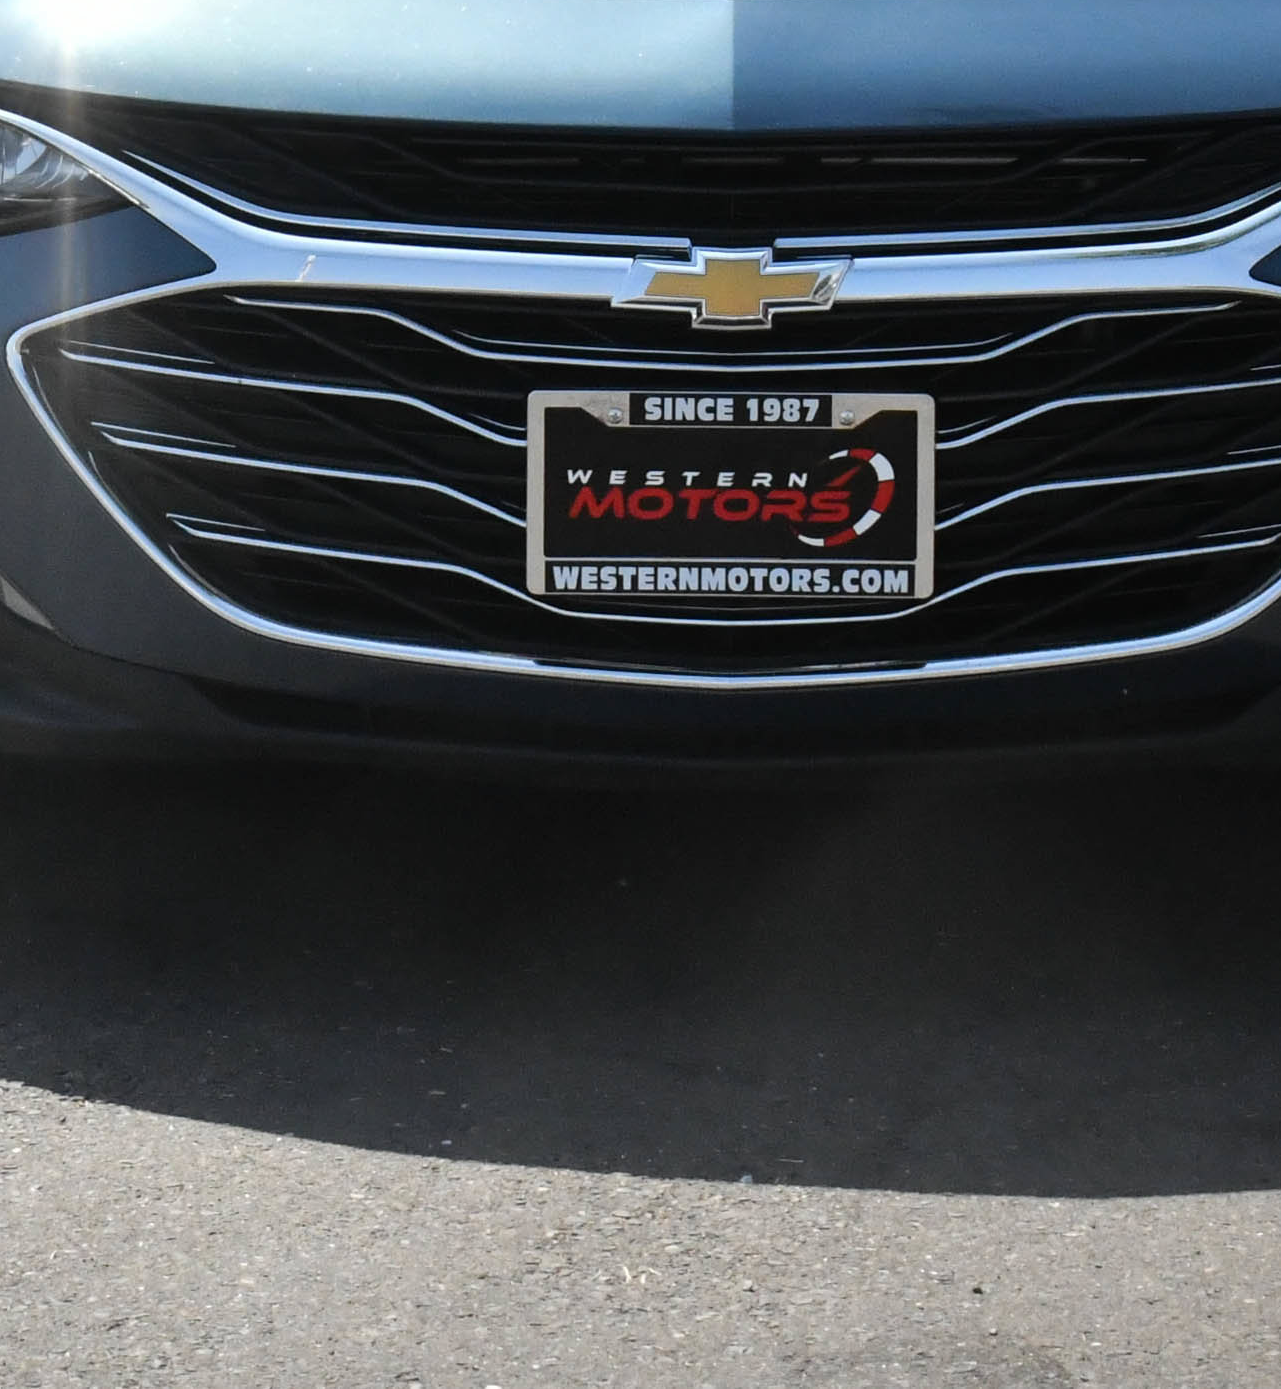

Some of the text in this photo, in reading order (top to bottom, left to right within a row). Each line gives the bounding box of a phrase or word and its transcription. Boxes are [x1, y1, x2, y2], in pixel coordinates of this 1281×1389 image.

[643, 396, 821, 423] SINCE 1987
[566, 468, 809, 489] WESTERN
[568, 485, 852, 523] MOTORS
[552, 564, 910, 594] WESTERNMOTORS.COM
